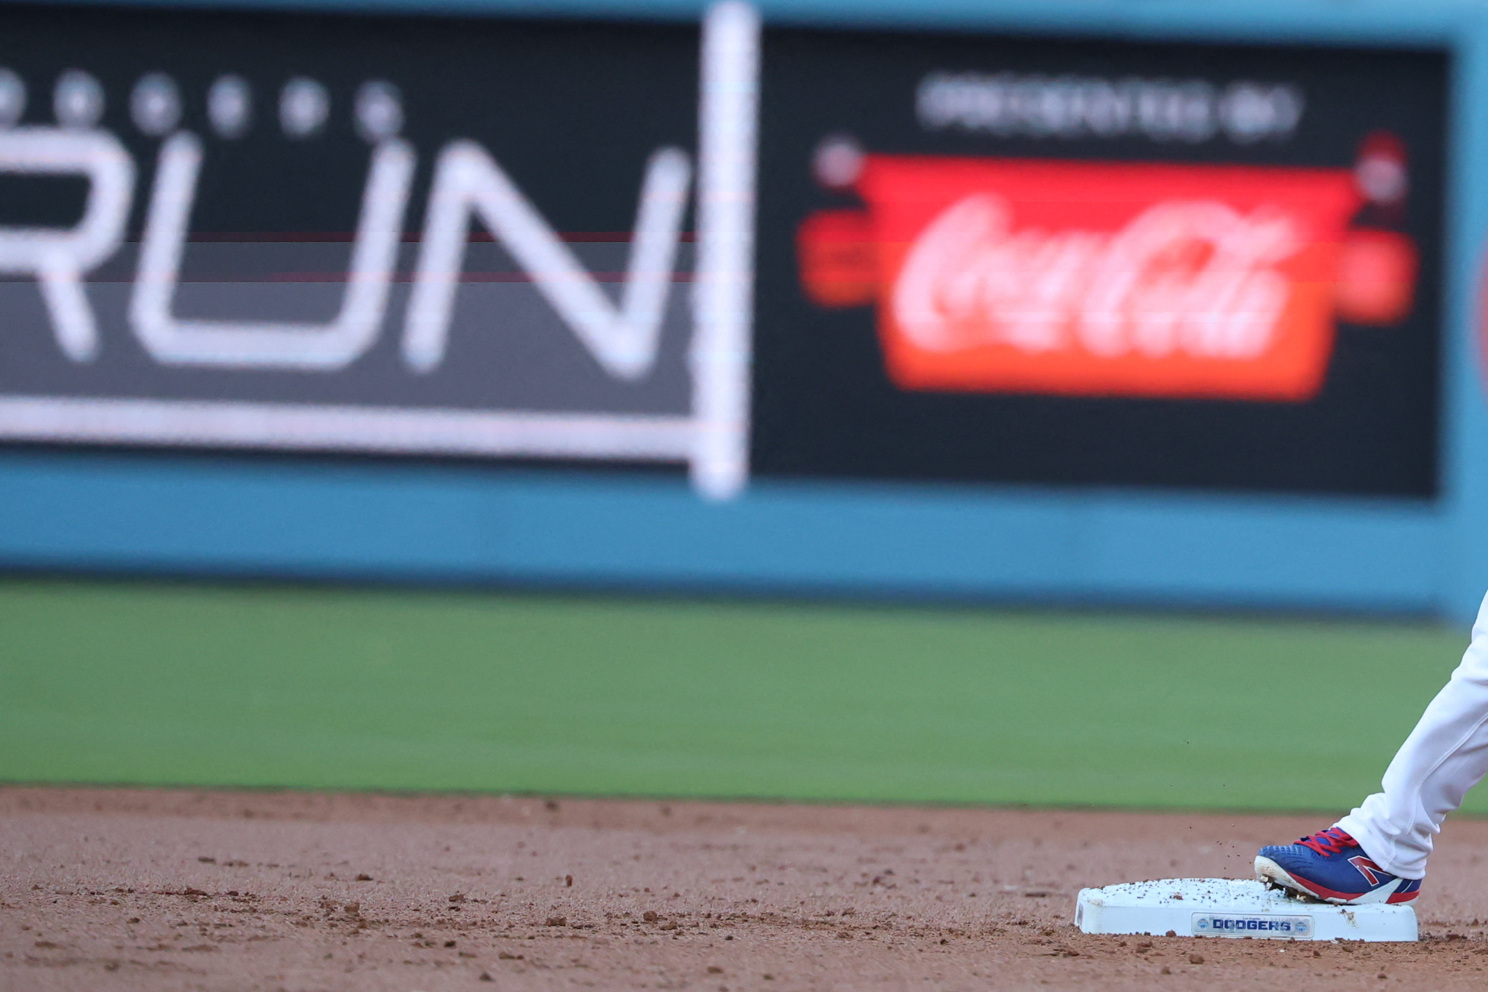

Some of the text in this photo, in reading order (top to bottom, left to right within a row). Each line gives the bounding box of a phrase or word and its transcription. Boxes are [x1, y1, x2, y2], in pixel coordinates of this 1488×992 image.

[0, 124, 694, 382] RUN
[890, 192, 1303, 360] Coca-Cola
[1212, 918, 1292, 932] DODGERS
